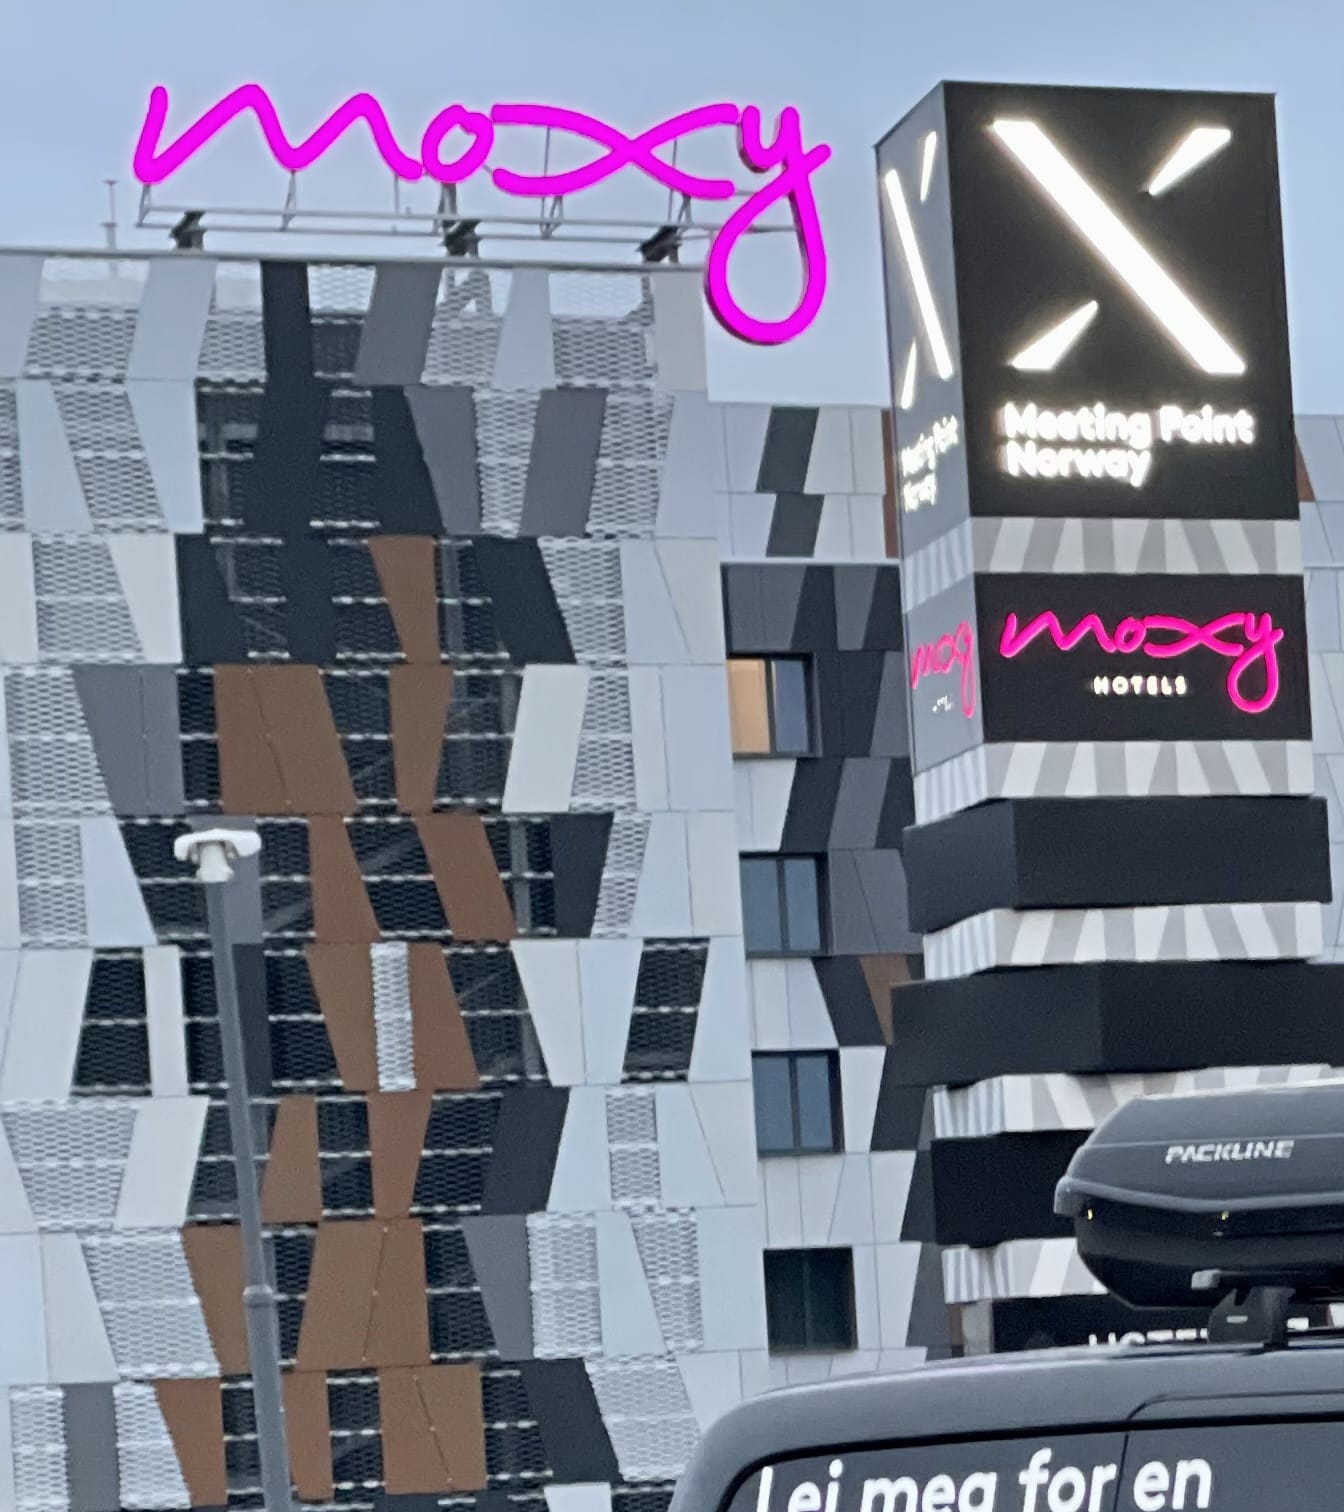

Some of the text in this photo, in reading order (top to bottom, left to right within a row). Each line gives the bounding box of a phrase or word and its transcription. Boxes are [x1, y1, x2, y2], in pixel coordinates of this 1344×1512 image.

[132, 83, 833, 346] moxy
[1003, 401, 1255, 451] Meeting Point
[1005, 439, 1152, 488] Norway
[1000, 610, 1285, 714] moxy
[1092, 674, 1188, 695] HOTELS
[1164, 1139, 1295, 1165] PACKLINE
[1133, 1458, 1212, 1512] en
